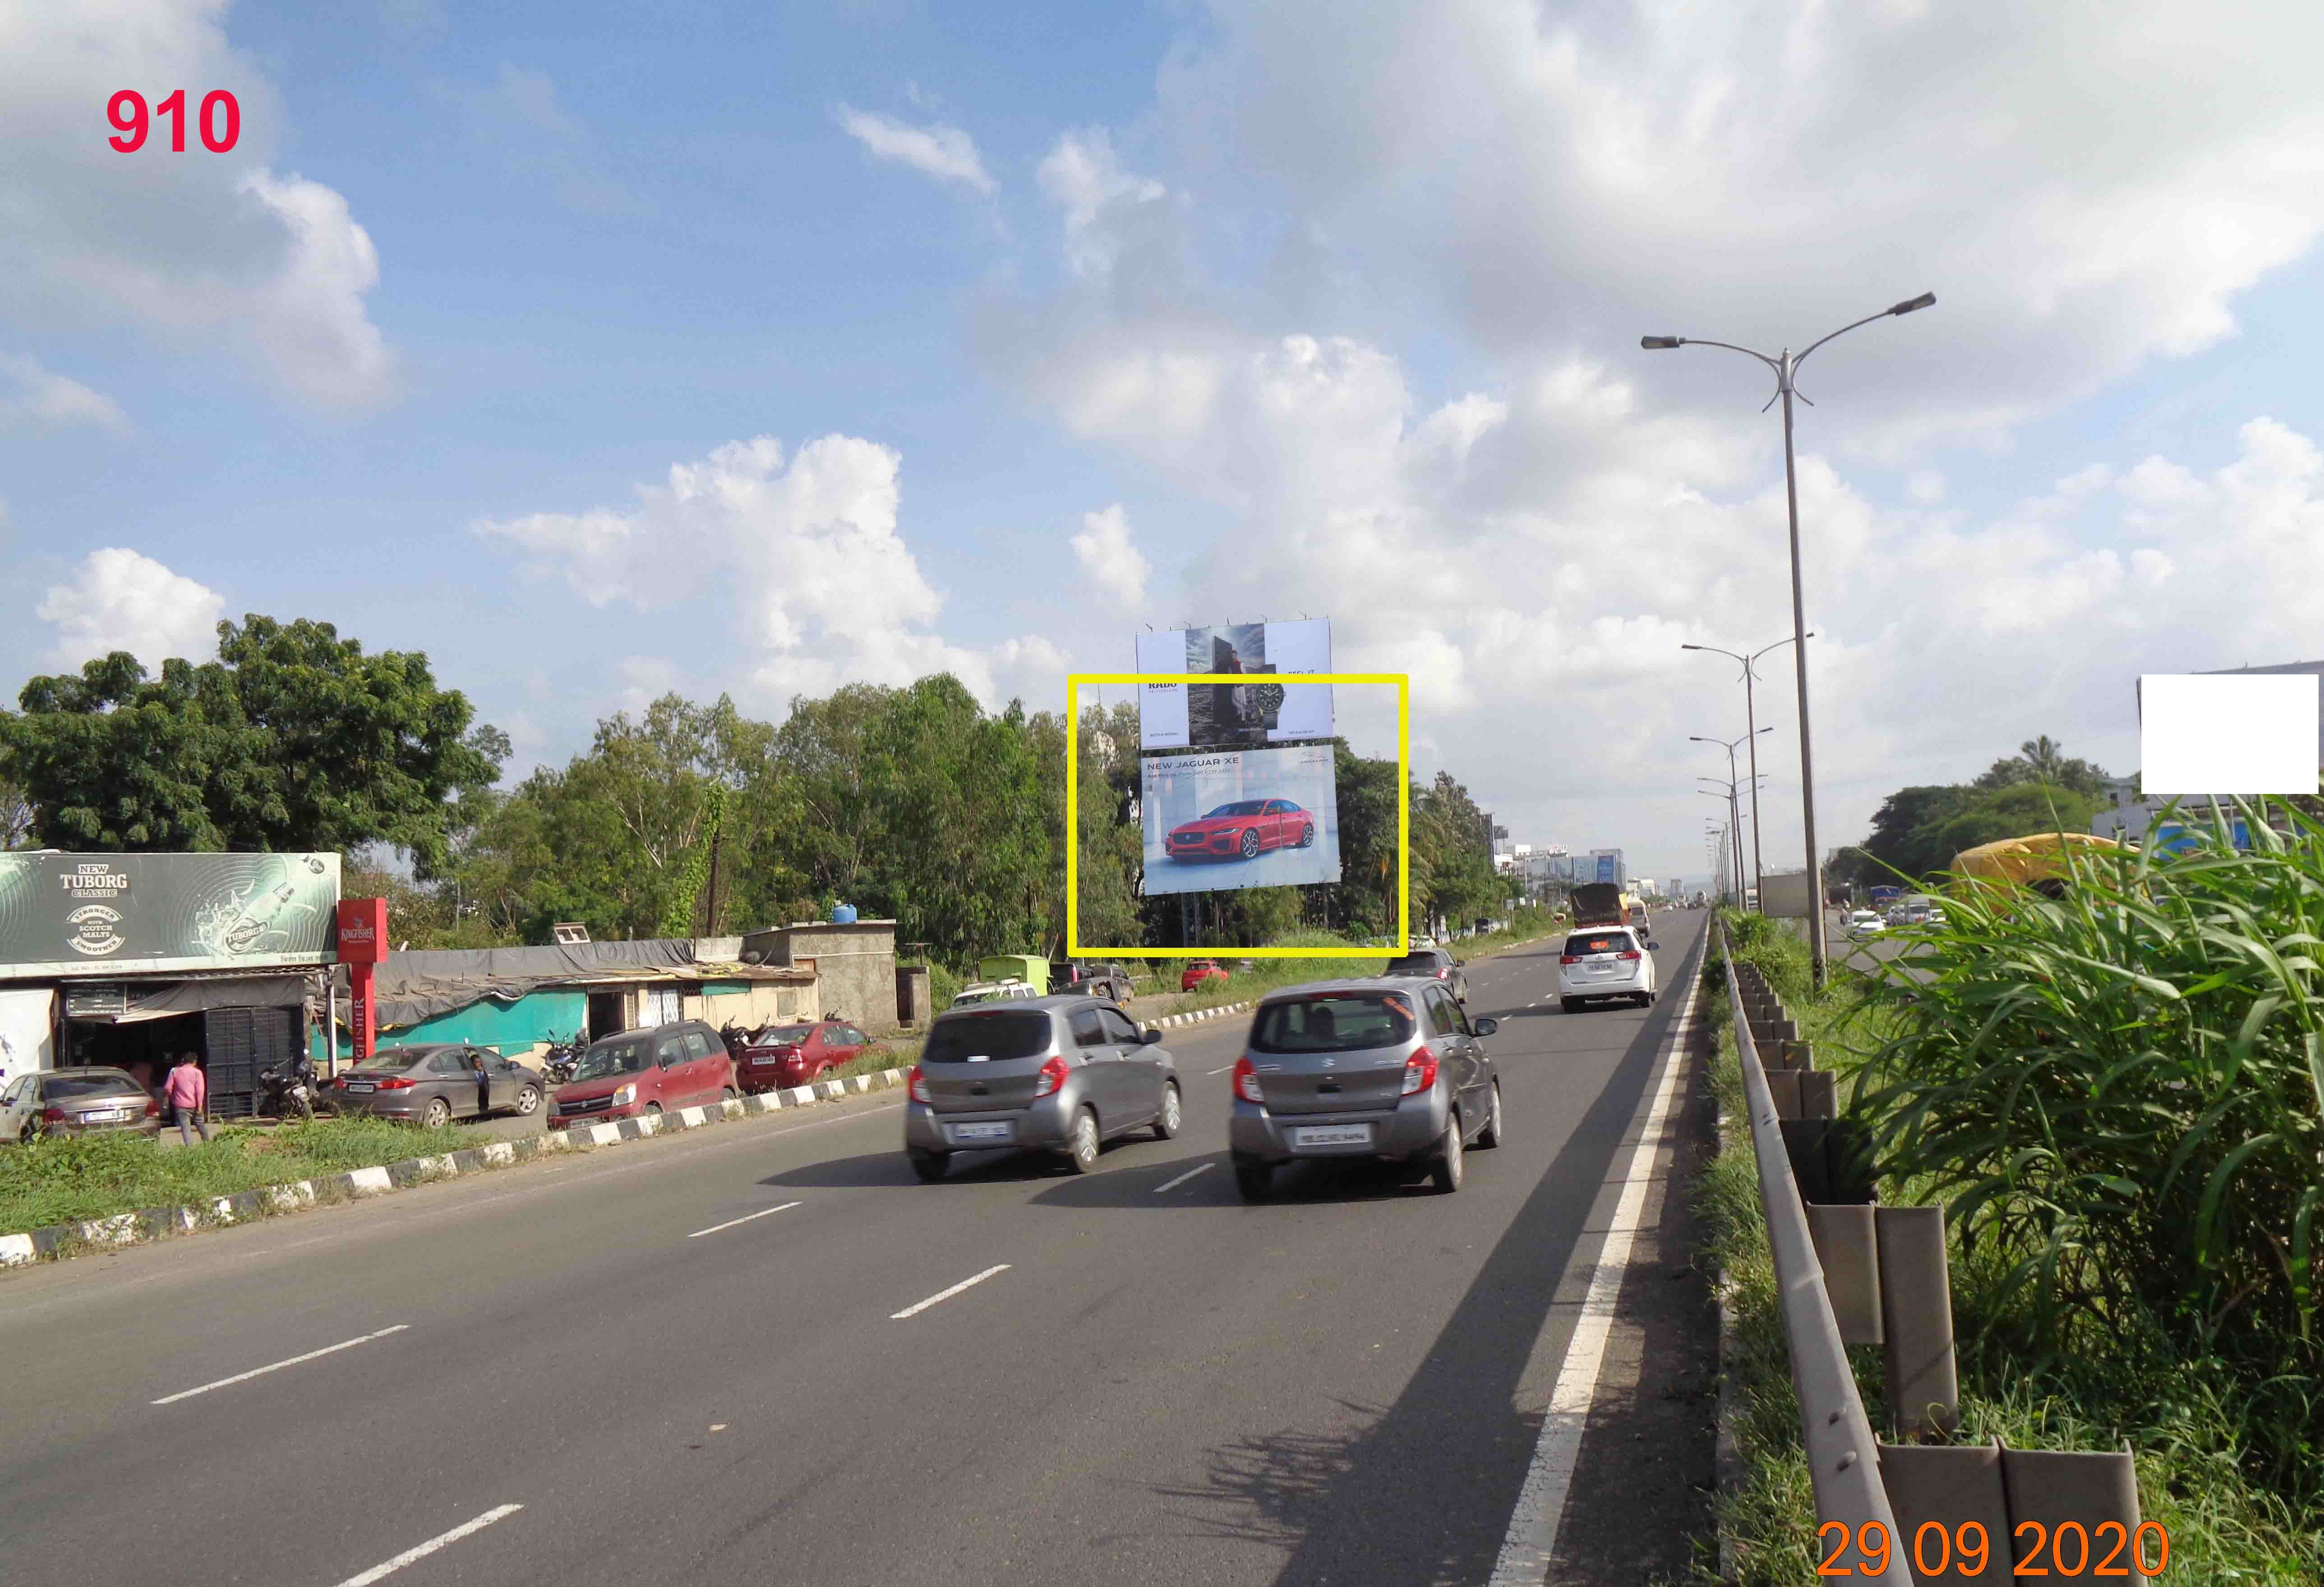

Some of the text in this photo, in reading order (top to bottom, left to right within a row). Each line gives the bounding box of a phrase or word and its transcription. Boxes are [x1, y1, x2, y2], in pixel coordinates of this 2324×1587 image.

[1176, 758, 1220, 768] JAGUAR
[80, 865, 107, 873] NEW
[60, 874, 127, 889] TUBORG
[74, 908, 115, 919] STRONGER
[228, 927, 260, 941] TUBORG
[341, 927, 375, 941] KINGFISHER
[75, 940, 117, 952] SMOOTHER
[354, 998, 365, 1061] GFISHER
